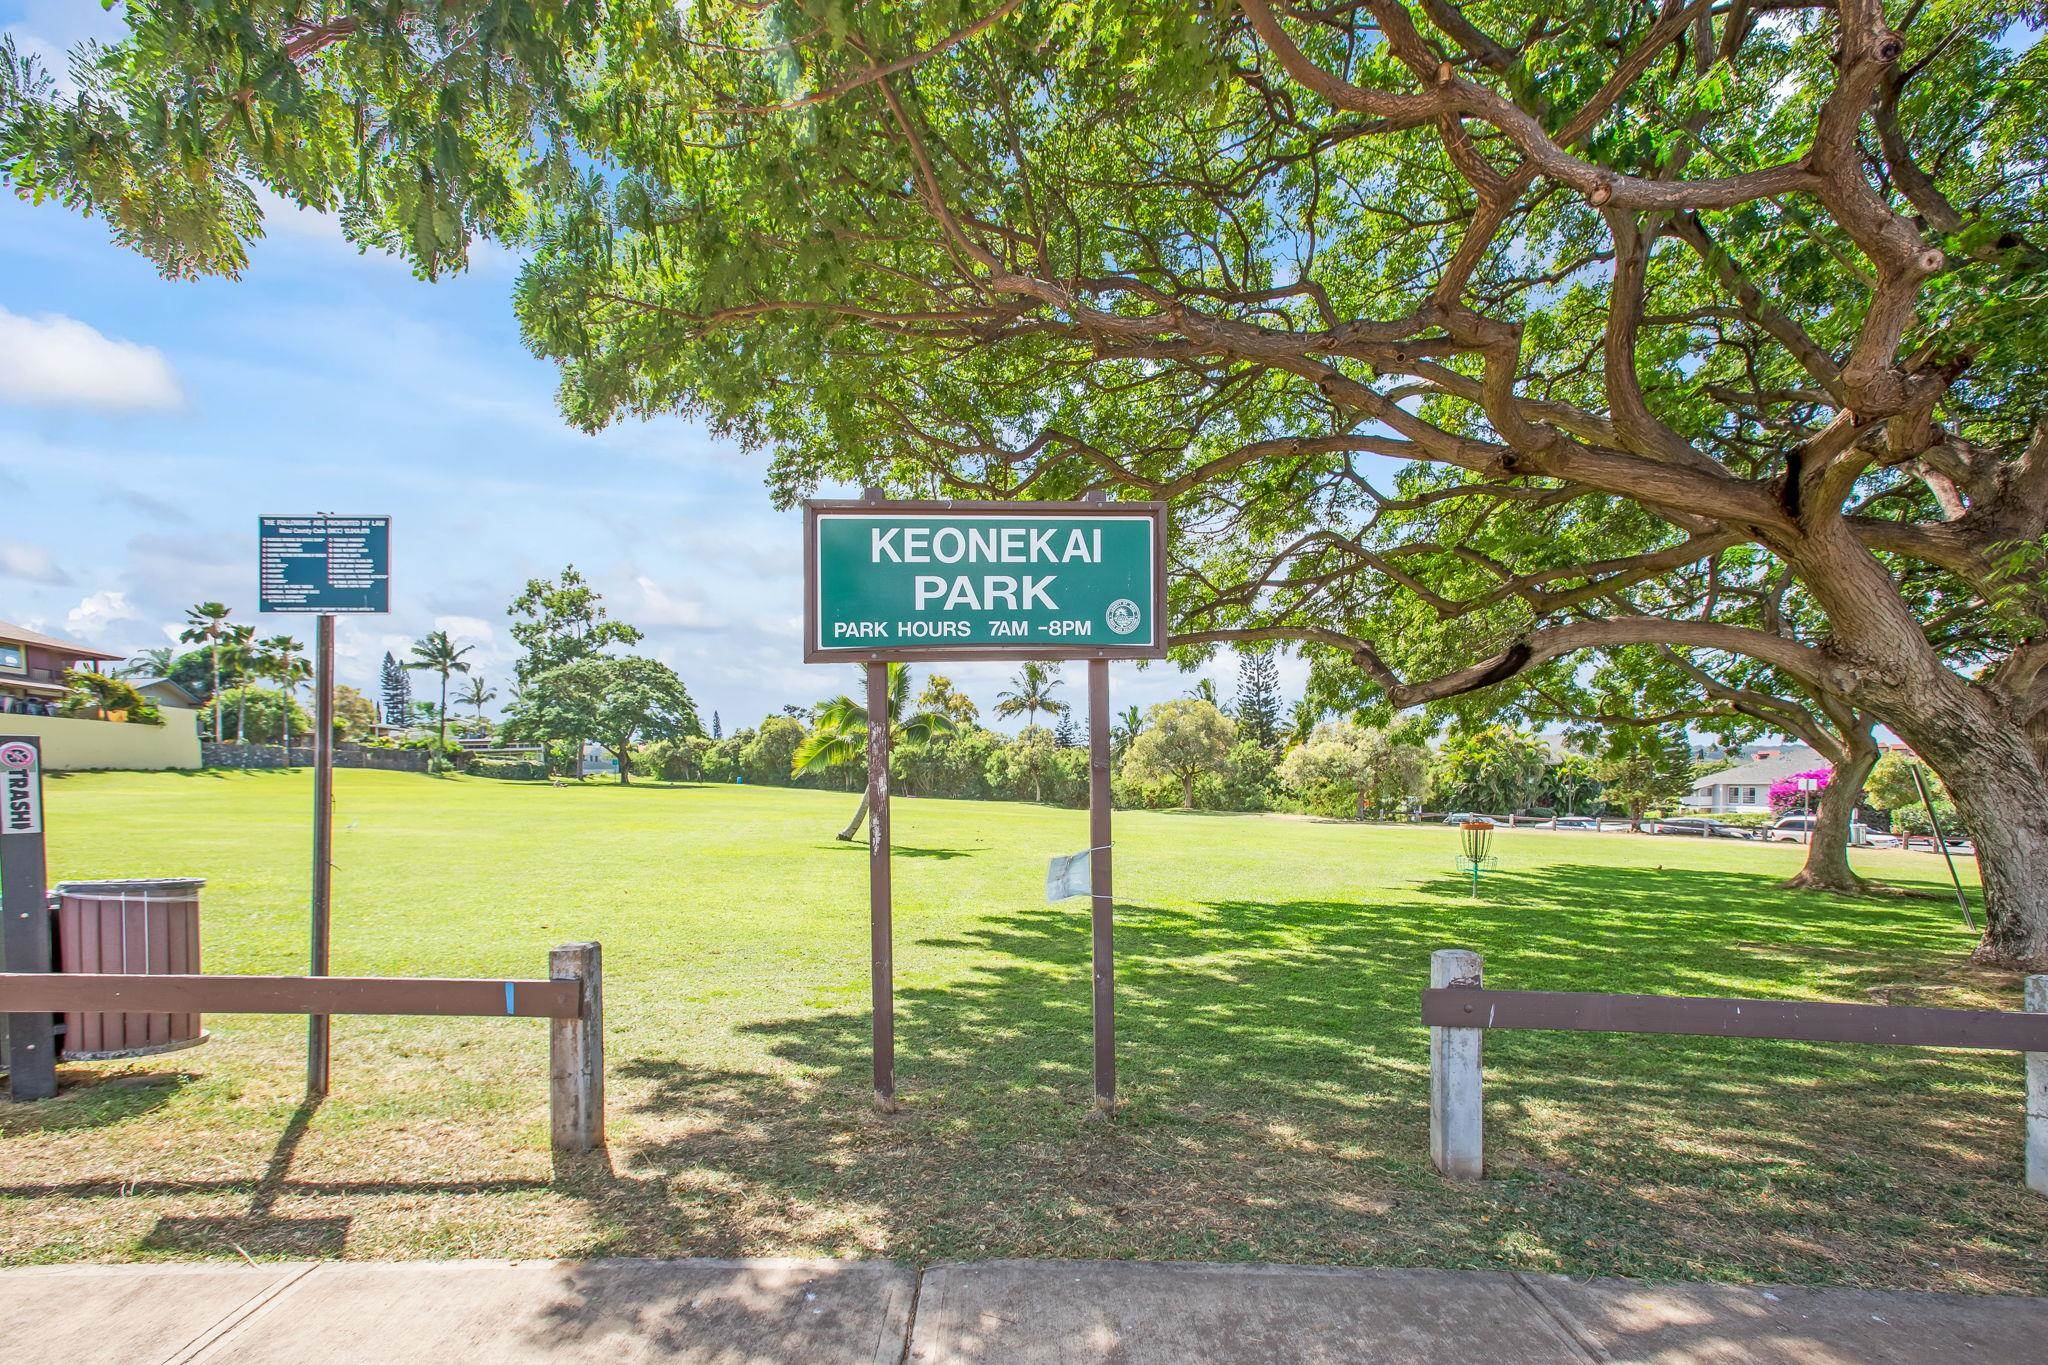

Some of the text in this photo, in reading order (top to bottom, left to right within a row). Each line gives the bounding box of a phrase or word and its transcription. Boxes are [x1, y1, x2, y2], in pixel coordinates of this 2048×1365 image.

[871, 527, 1102, 564] KEONEKAI
[914, 575, 1060, 611] PARK
[834, 621, 889, 638] PARK
[898, 620, 971, 637] HOURS
[988, 620, 1029, 636] 7AM
[8, 769, 30, 822] TRASH
